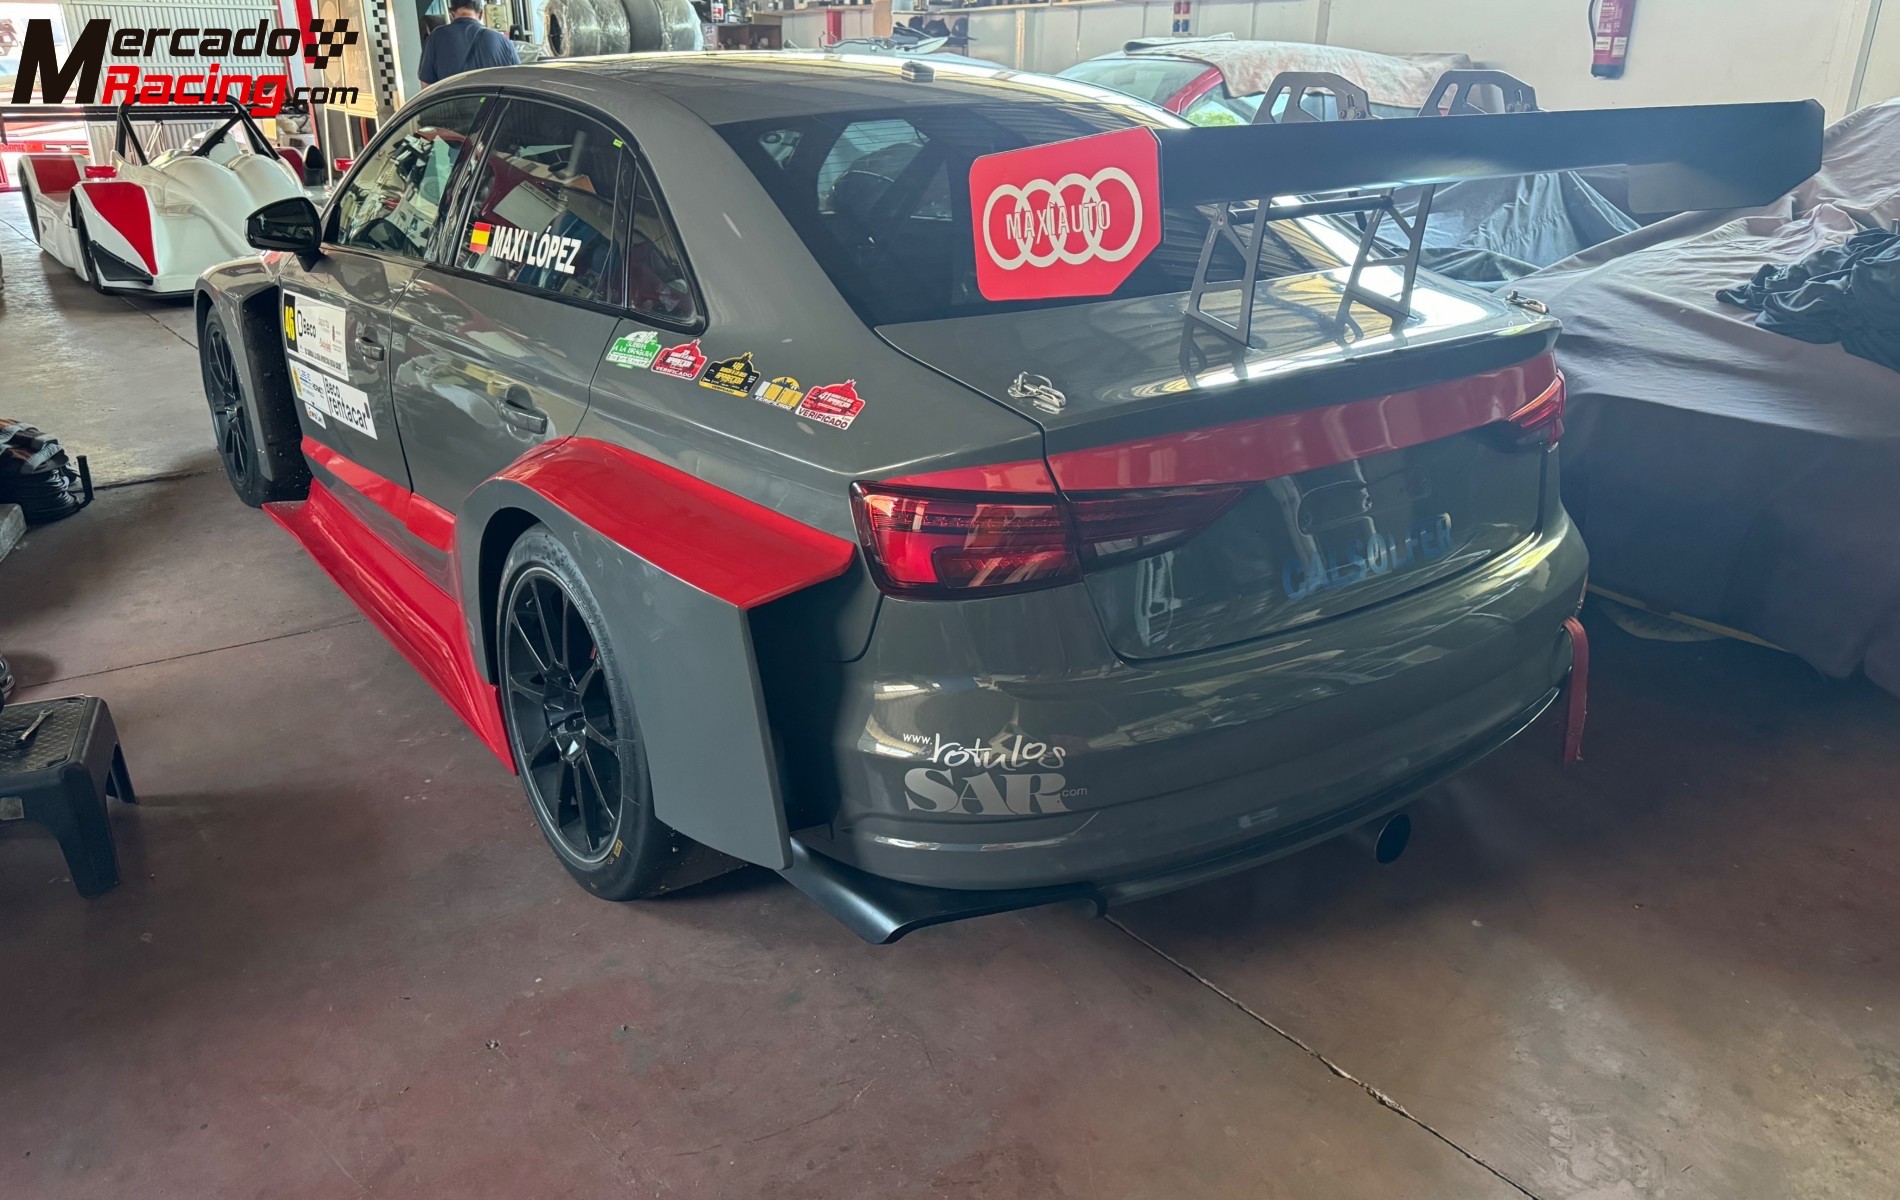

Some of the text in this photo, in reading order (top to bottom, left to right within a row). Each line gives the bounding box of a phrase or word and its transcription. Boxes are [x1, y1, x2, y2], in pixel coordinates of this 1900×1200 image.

[490, 225, 582, 275] MAXI LÓPEZ
[303, 318, 317, 338] Beco
[656, 367, 693, 378] VERIFICADO
[328, 396, 369, 430] rentacar
[798, 408, 849, 429] VERIFICADO
[904, 767, 1073, 815] SAR
